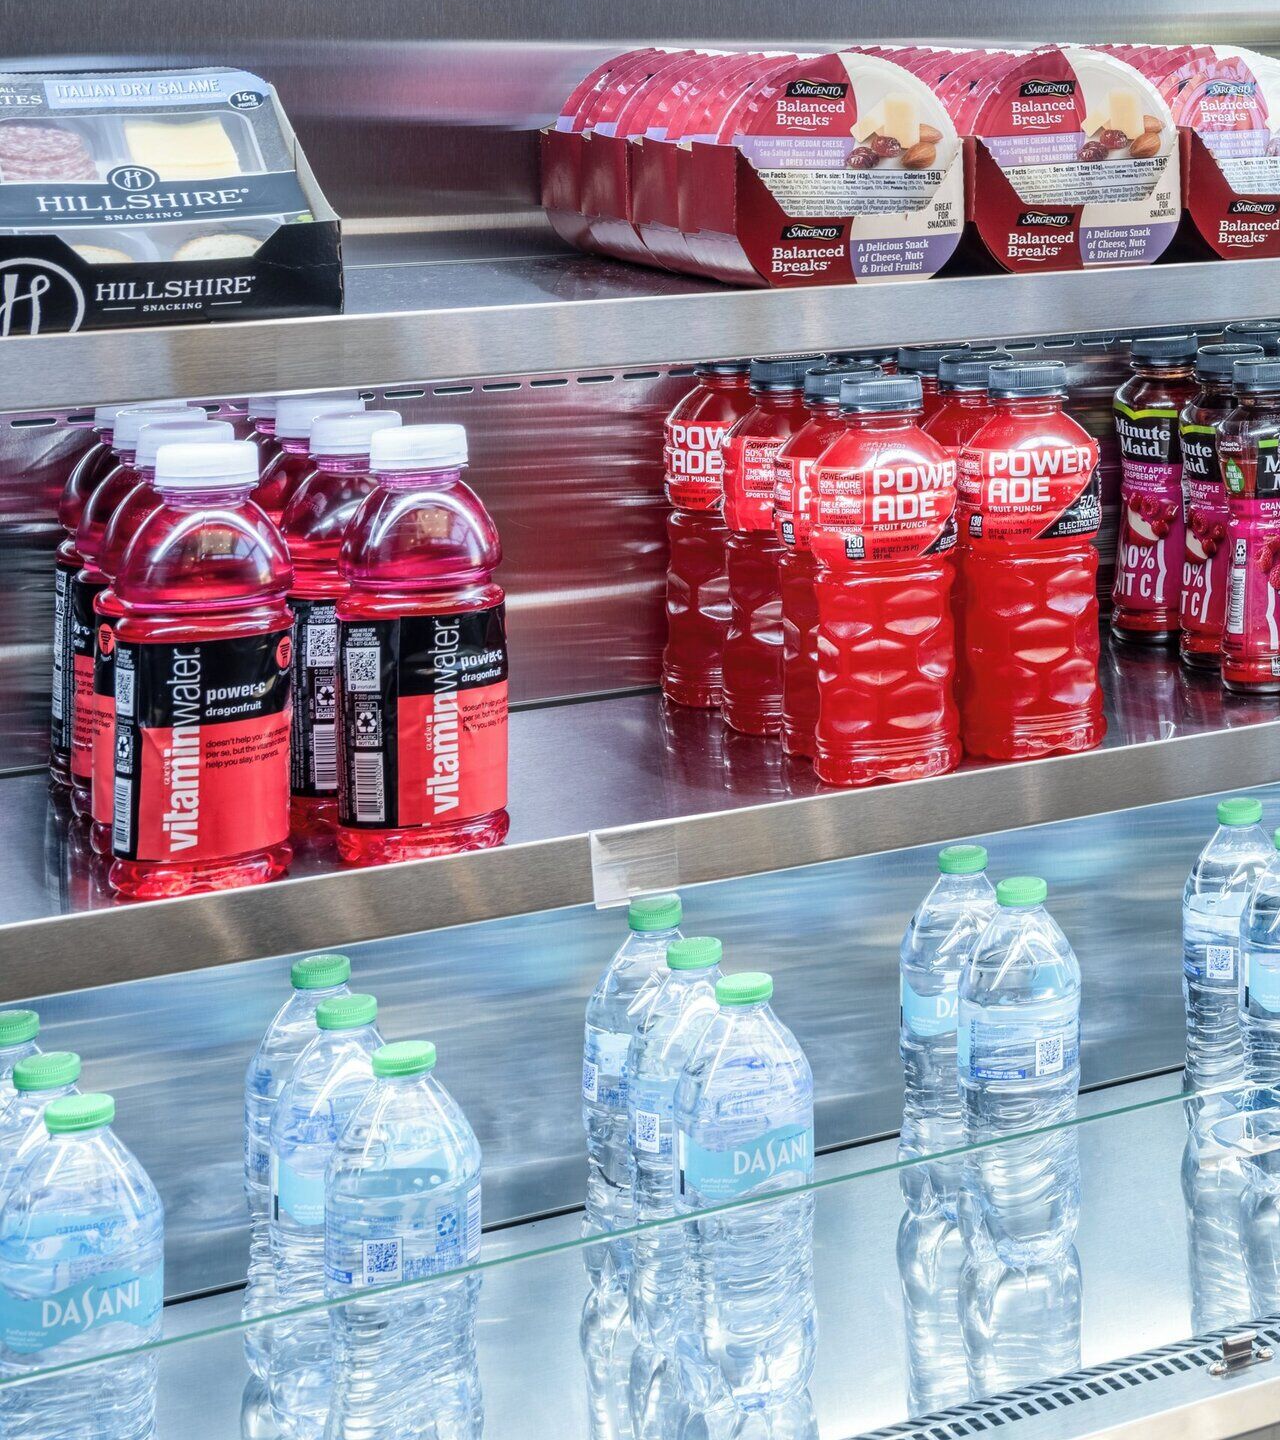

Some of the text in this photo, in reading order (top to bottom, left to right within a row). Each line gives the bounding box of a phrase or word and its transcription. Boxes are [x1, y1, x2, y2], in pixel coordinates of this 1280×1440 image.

[55, 79, 220, 98] ITALIAN DRY SALAME
[792, 83, 841, 95] SARGENTO
[236, 92, 256, 104] 16g
[776, 101, 845, 113] Balanced
[776, 114, 829, 126] Breaks
[903, 172, 926, 180] Calories
[37, 188, 243, 213] HILLSHIRE
[1231, 201, 1277, 213] SARGENTO
[934, 203, 953, 212] GREAT
[104, 211, 183, 222] SNACKING
[1022, 214, 1071, 225] SARGENTO
[786, 227, 840, 239] SARGENTO
[1218, 220, 1280, 233] Balanced
[1007, 232, 1074, 246] Balanced
[1218, 231, 1266, 244] Breaks
[867, 239, 929, 251] Delicious Snack
[1007, 245, 1059, 257] Breaks
[772, 245, 845, 260] Balanced
[859, 251, 924, 263] of Cheese, Nuts
[771, 259, 828, 273] Breaks
[870, 262, 923, 273] Dried Fruits!
[95, 276, 251, 302] HILLSHIRE
[142, 302, 202, 312] SNACKING
[1115, 417, 1170, 443] Minute
[1120, 435, 1163, 458] Maid
[988, 447, 1091, 477] POWER
[988, 477, 1050, 503] ADE
[872, 491, 936, 522] ADE
[874, 521, 927, 531] FRUIT PUNCH
[846, 537, 862, 548] 130
[206, 682, 266, 704] power-c
[206, 701, 262, 717] dragonfruit
[162, 647, 200, 852] vitaminwater
[733, 1133, 807, 1178] DASANI
[41, 1278, 141, 1331] DASANI
